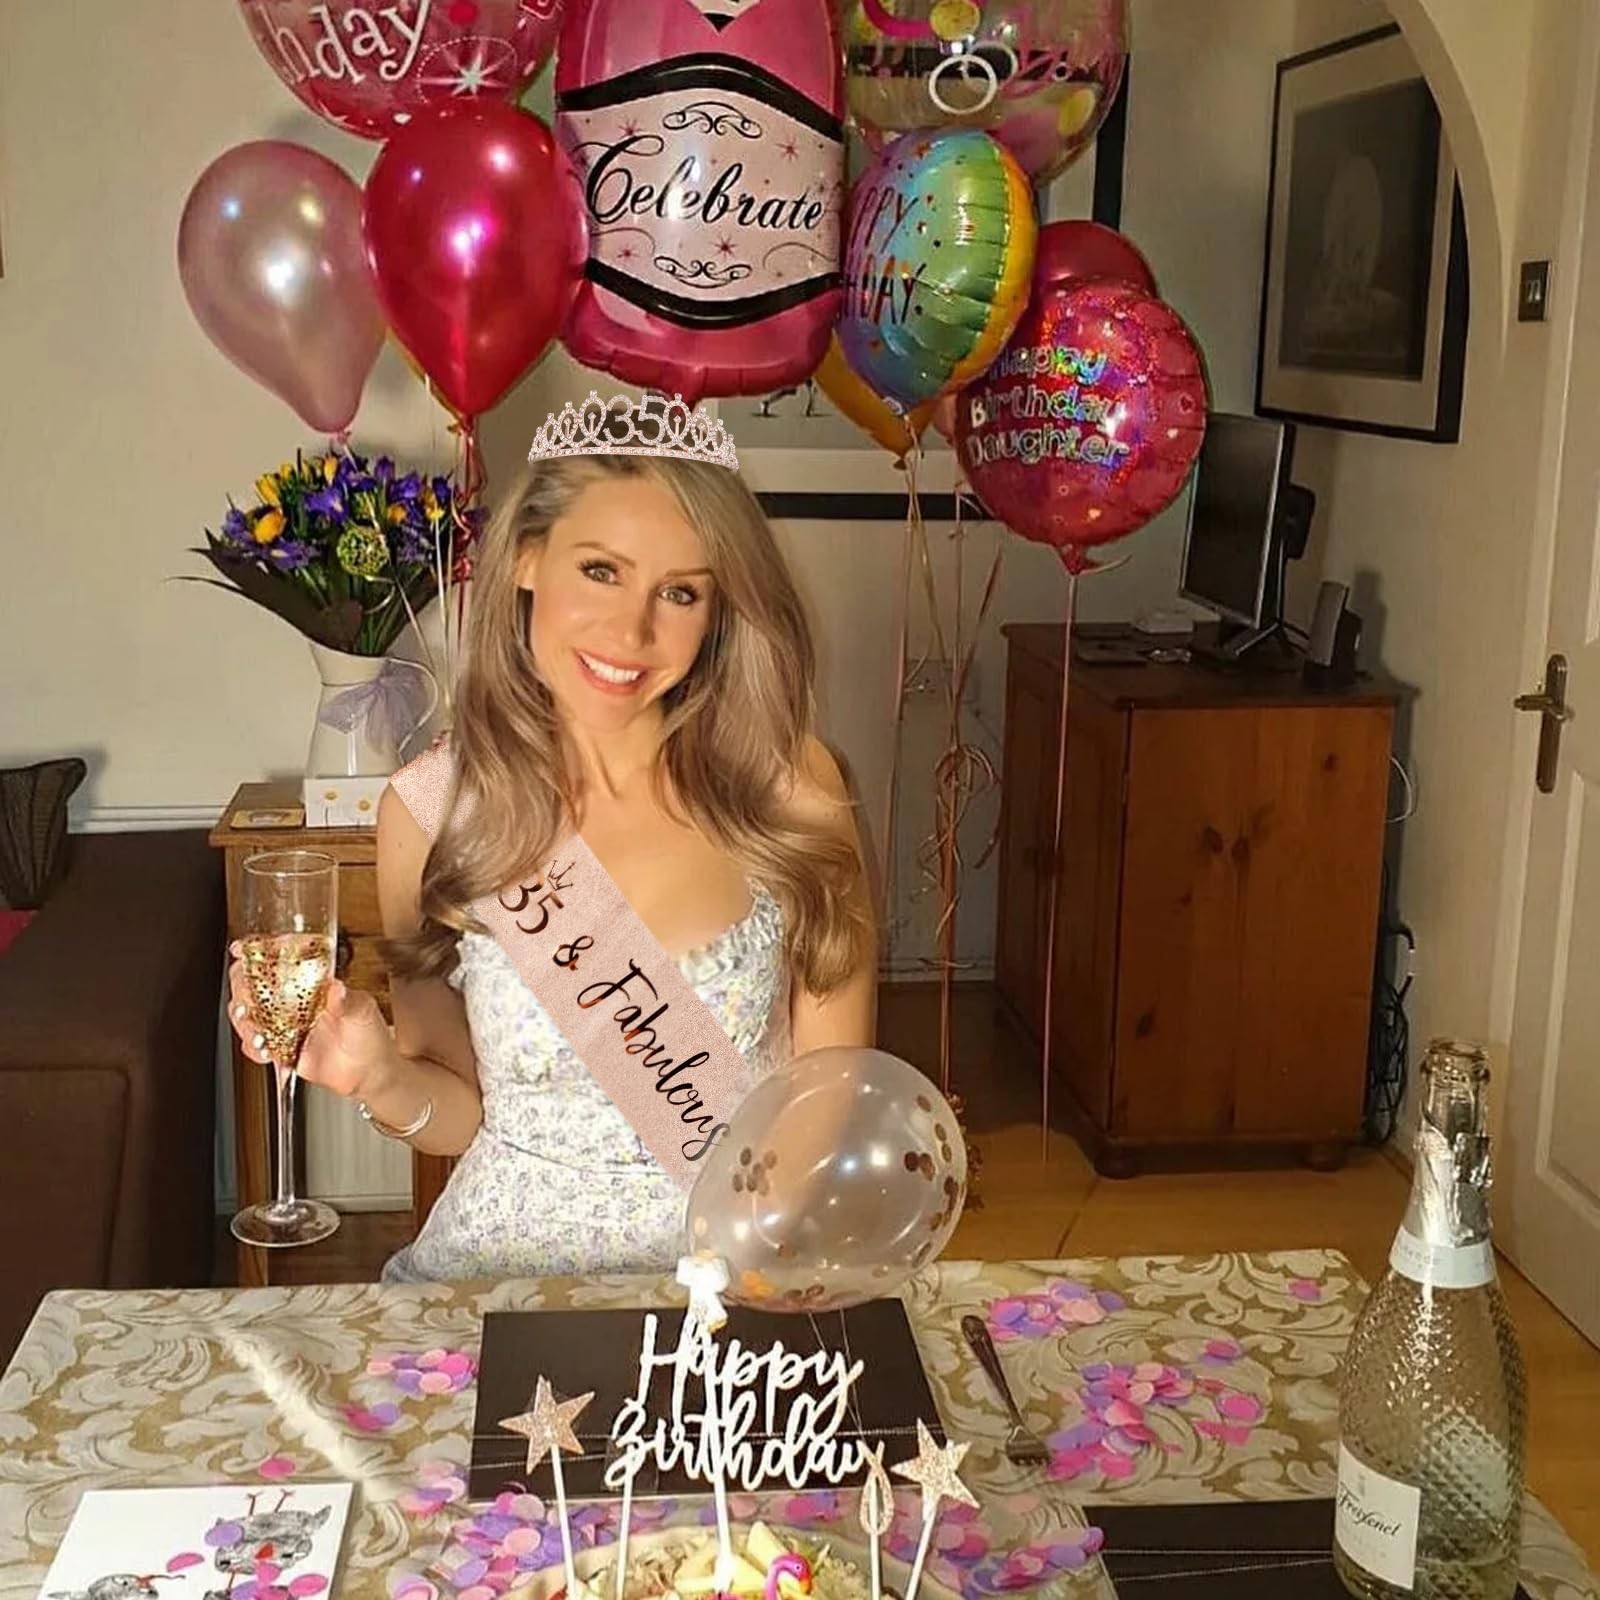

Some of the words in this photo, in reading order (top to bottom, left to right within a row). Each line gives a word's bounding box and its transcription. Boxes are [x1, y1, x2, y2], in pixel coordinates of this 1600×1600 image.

[573, 134, 824, 230] Celebrate
[602, 394, 667, 445] 35
[966, 422, 1131, 467] Daughter
[969, 384, 1128, 437] Birthday
[498, 882, 565, 935] 35
[552, 935, 595, 972] &
[576, 958, 731, 1162] Fabulous
[639, 1313, 865, 1437] Happy
